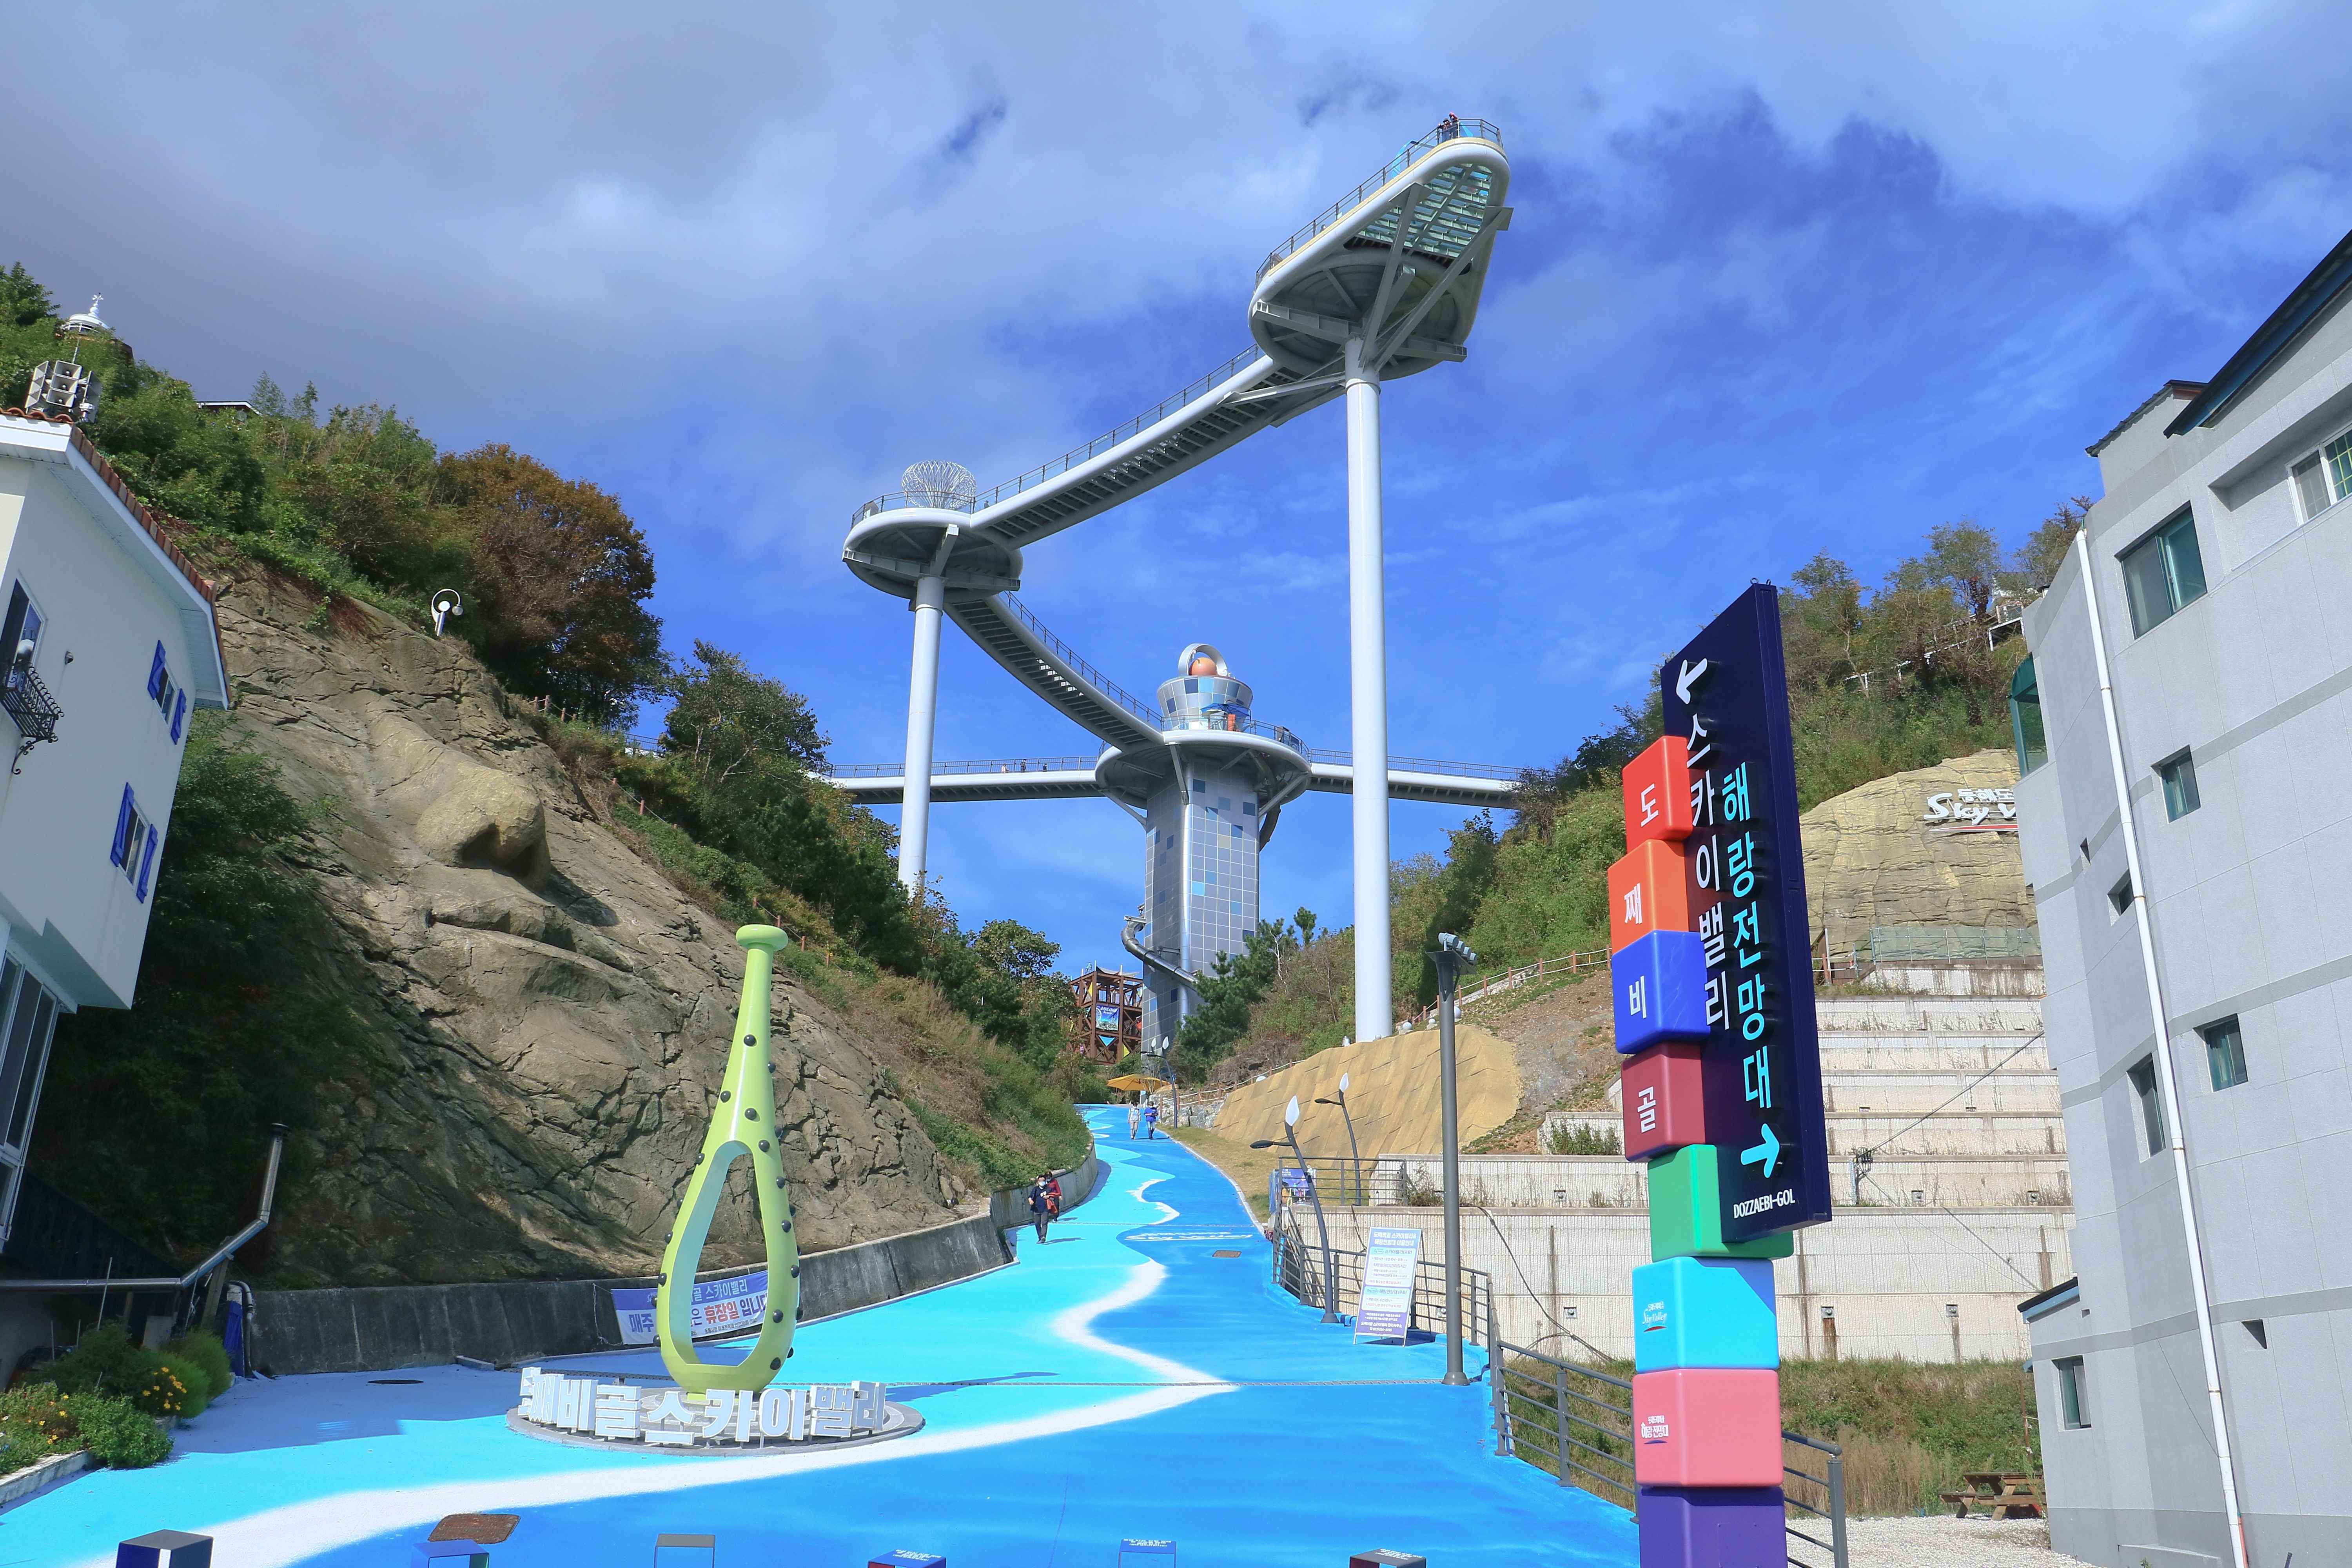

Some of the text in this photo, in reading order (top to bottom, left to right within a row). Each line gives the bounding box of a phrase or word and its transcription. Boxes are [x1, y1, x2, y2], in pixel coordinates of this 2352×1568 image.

[1924, 793, 1989, 826] Sky
[1686, 713, 1729, 1029] 스카이밸리
[1722, 762, 1771, 1109] 해랑전망대
[1733, 1189, 1795, 1219] DOZZAEBI-GOL
[706, 1279, 748, 1299] 스카이밸리
[629, 1313, 654, 1332] 매주
[704, 1301, 740, 1324] 휴장일
